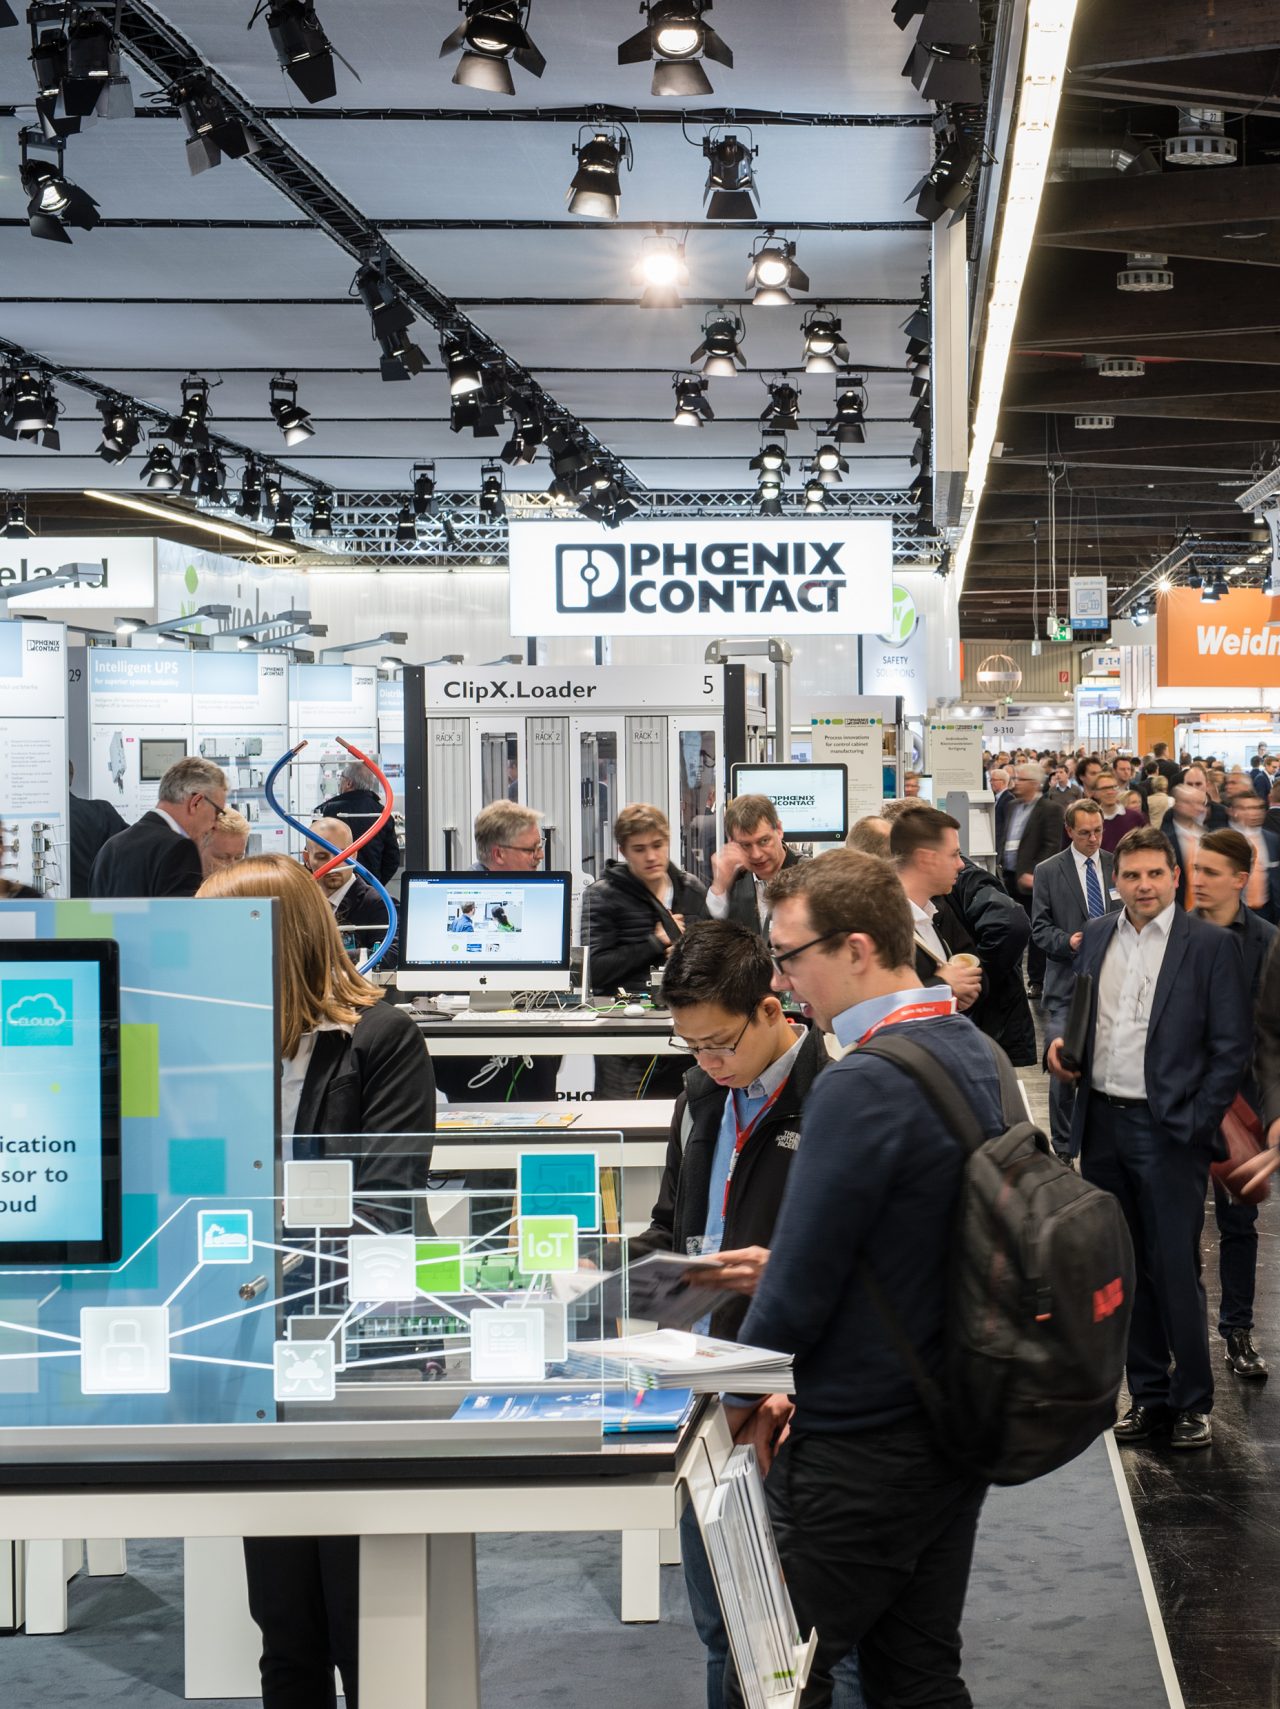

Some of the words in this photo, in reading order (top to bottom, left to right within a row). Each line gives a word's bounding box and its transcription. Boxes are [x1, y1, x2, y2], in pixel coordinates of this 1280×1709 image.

[630, 579, 847, 614] CONTACT
[882, 656, 909, 665] SAFETY
[95, 660, 152, 676] Intelligent
[155, 662, 179, 675] UPS
[69, 669, 82, 682] 29
[443, 680, 597, 703] ClipX.Loader
[702, 675, 714, 694] 5
[535, 733, 553, 741] RACK
[555, 732, 561, 741] 2
[634, 731, 653, 740] RACK
[654, 731, 659, 739] 1
[993, 726, 1014, 735] 9-310
[435, 734, 455, 742] RACK
[456, 734, 461, 742] 3
[18, 1016, 56, 1027] CLOUD
[0, 1168, 36, 1183] sor
[44, 1166, 69, 1183] to
[528, 1232, 570, 1258] IoT
